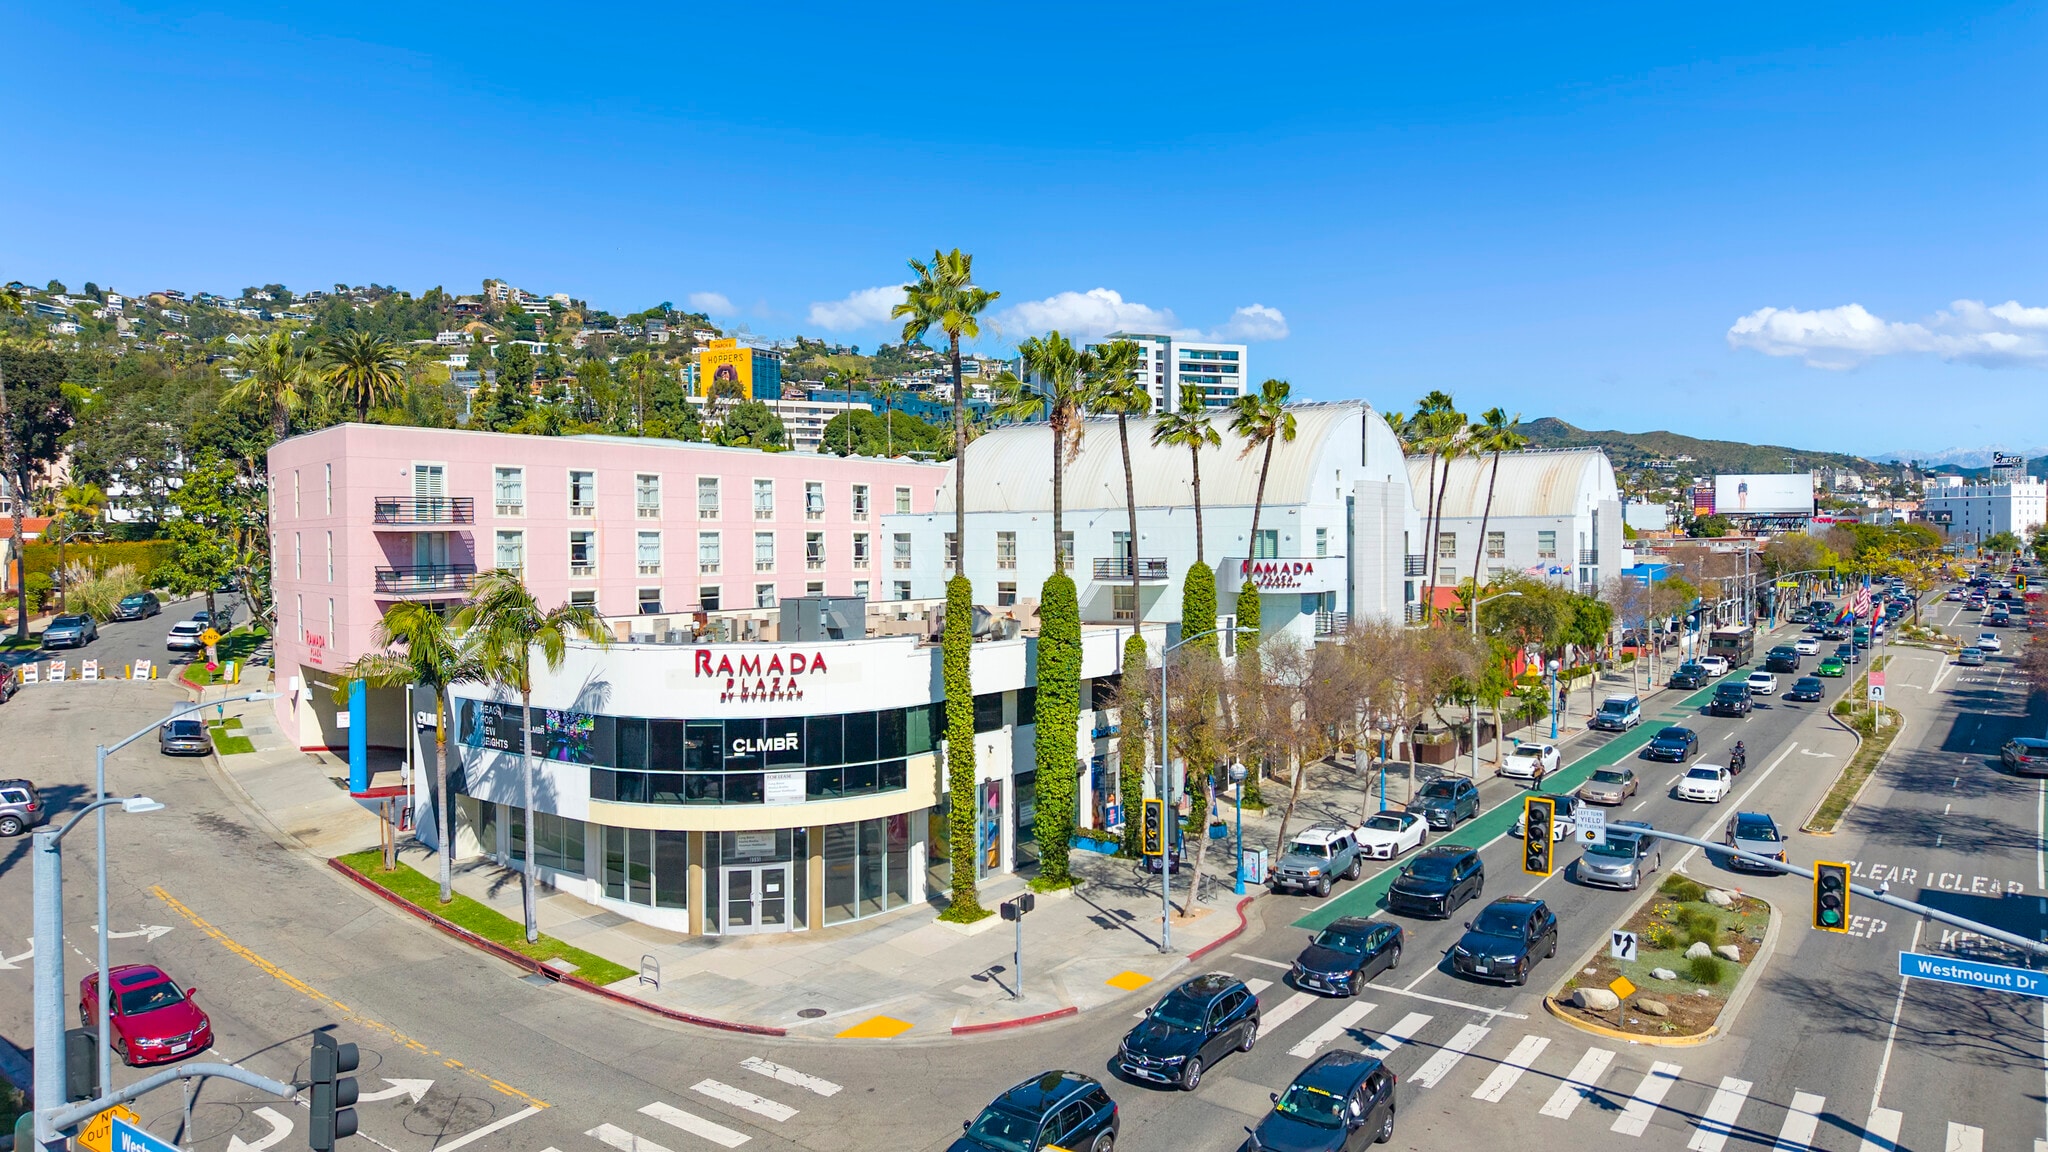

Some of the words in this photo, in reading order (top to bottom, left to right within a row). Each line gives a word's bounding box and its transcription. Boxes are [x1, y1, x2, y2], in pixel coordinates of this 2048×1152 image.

[708, 353, 744, 364] HOPPERS
[695, 649, 828, 678] RAMADA
[727, 677, 797, 692] PLAZA
[720, 692, 735, 704] BY
[740, 690, 804, 704] WYNDHAM
[732, 732, 799, 756] CLMBR
[1938, 872, 2024, 899] CLEAR
[1918, 960, 2012, 987] Westmount
[2017, 974, 2039, 989] Dr
[101, 1109, 118, 1123] NO
[87, 1125, 111, 1142] OUT
[121, 1131, 153, 1152] West
